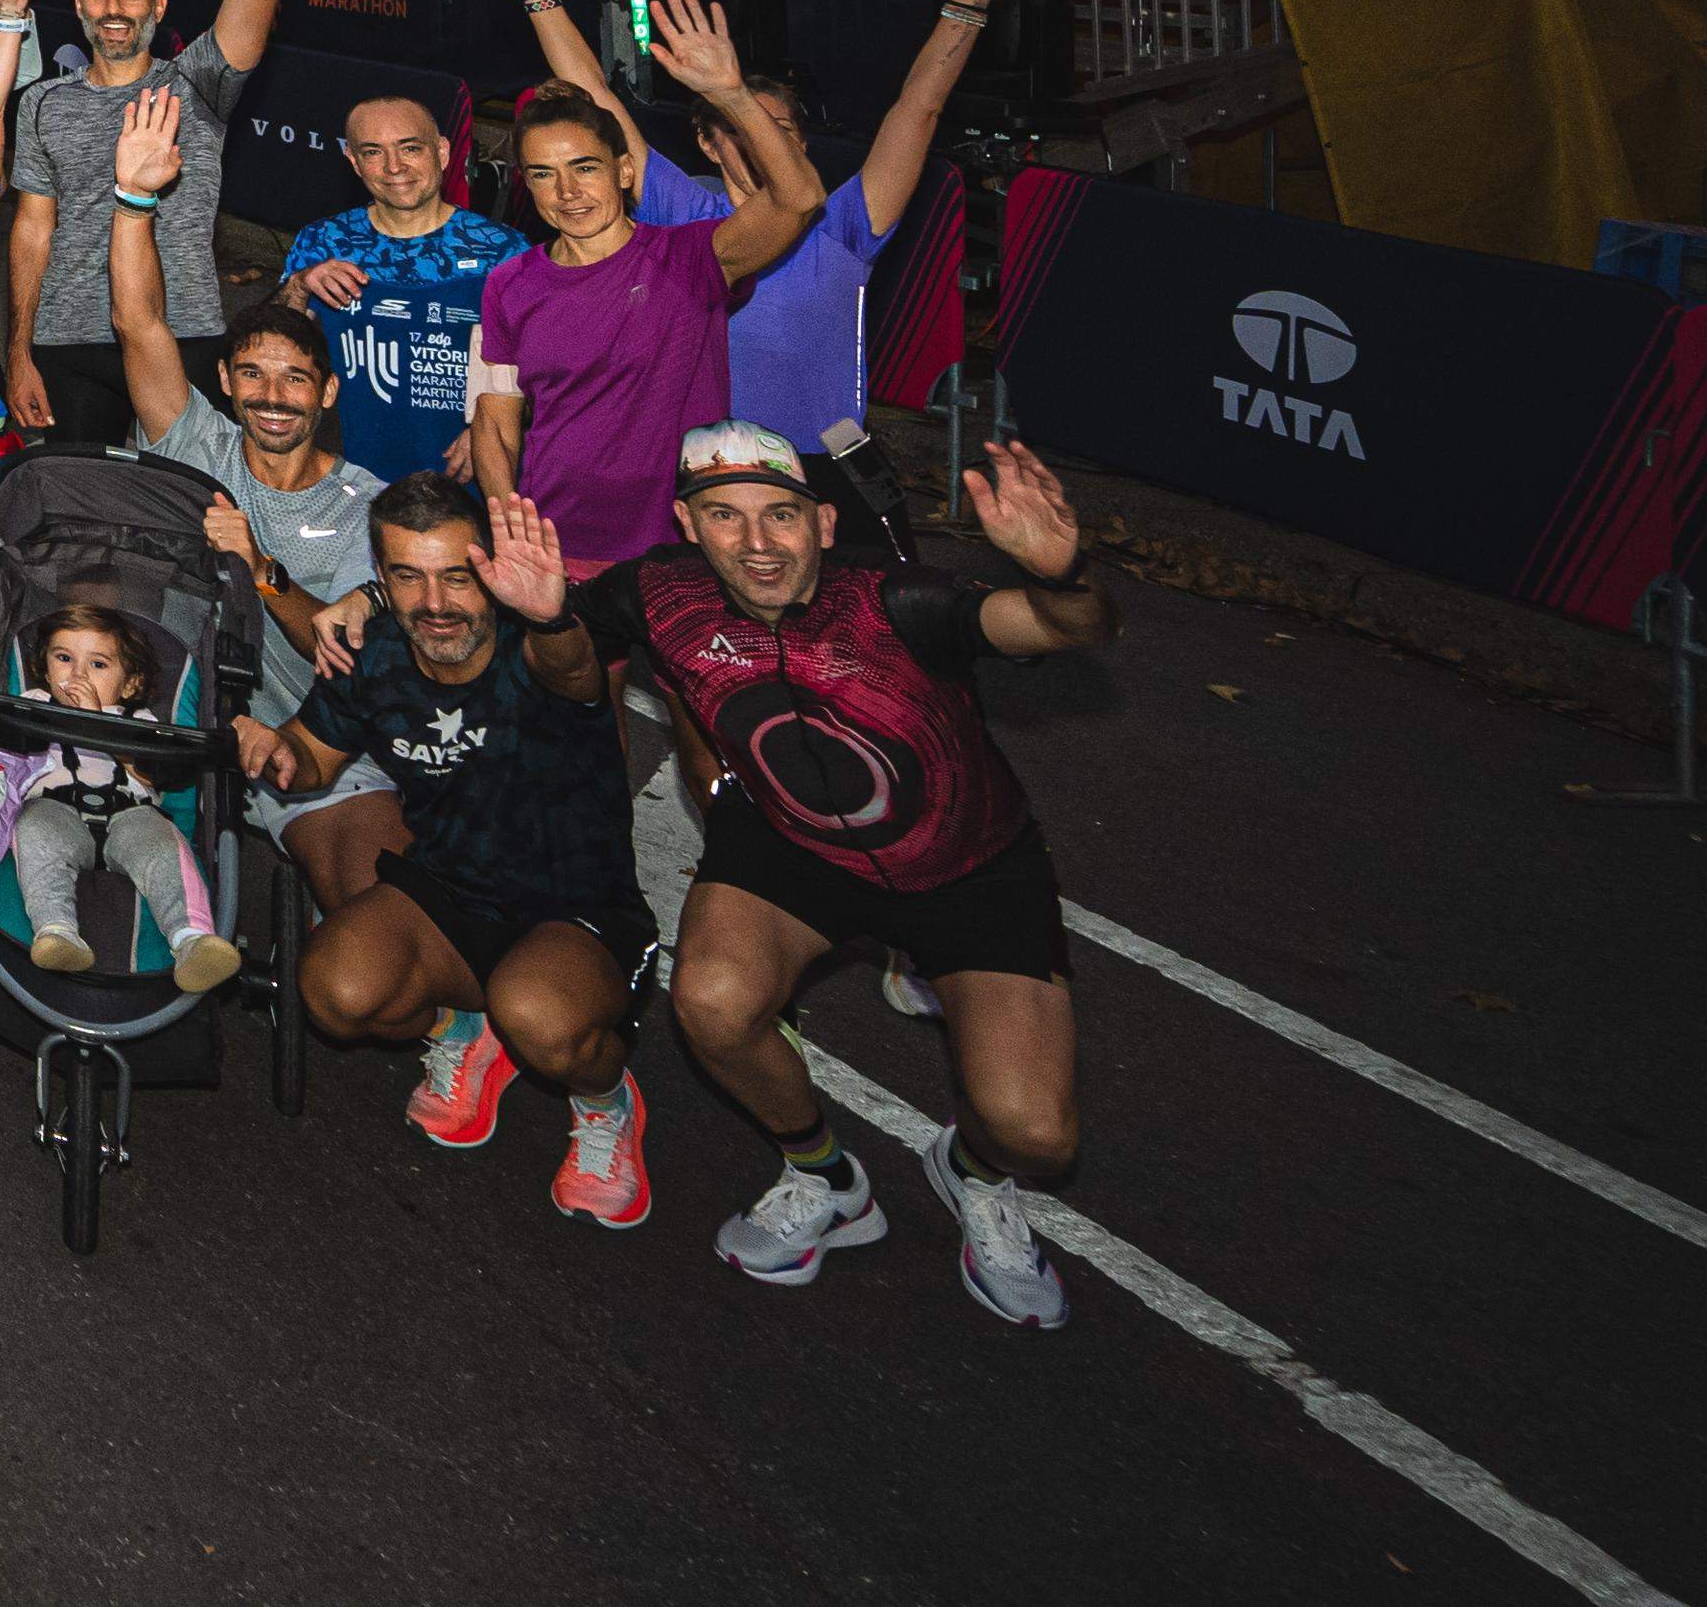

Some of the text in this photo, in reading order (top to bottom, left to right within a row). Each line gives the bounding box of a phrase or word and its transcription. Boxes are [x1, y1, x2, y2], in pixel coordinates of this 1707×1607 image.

[409, 331, 453, 349] 17. edp
[410, 386, 460, 399] MARTIN
[1212, 375, 1367, 461] TATA
[697, 649, 753, 668] ALTAN
